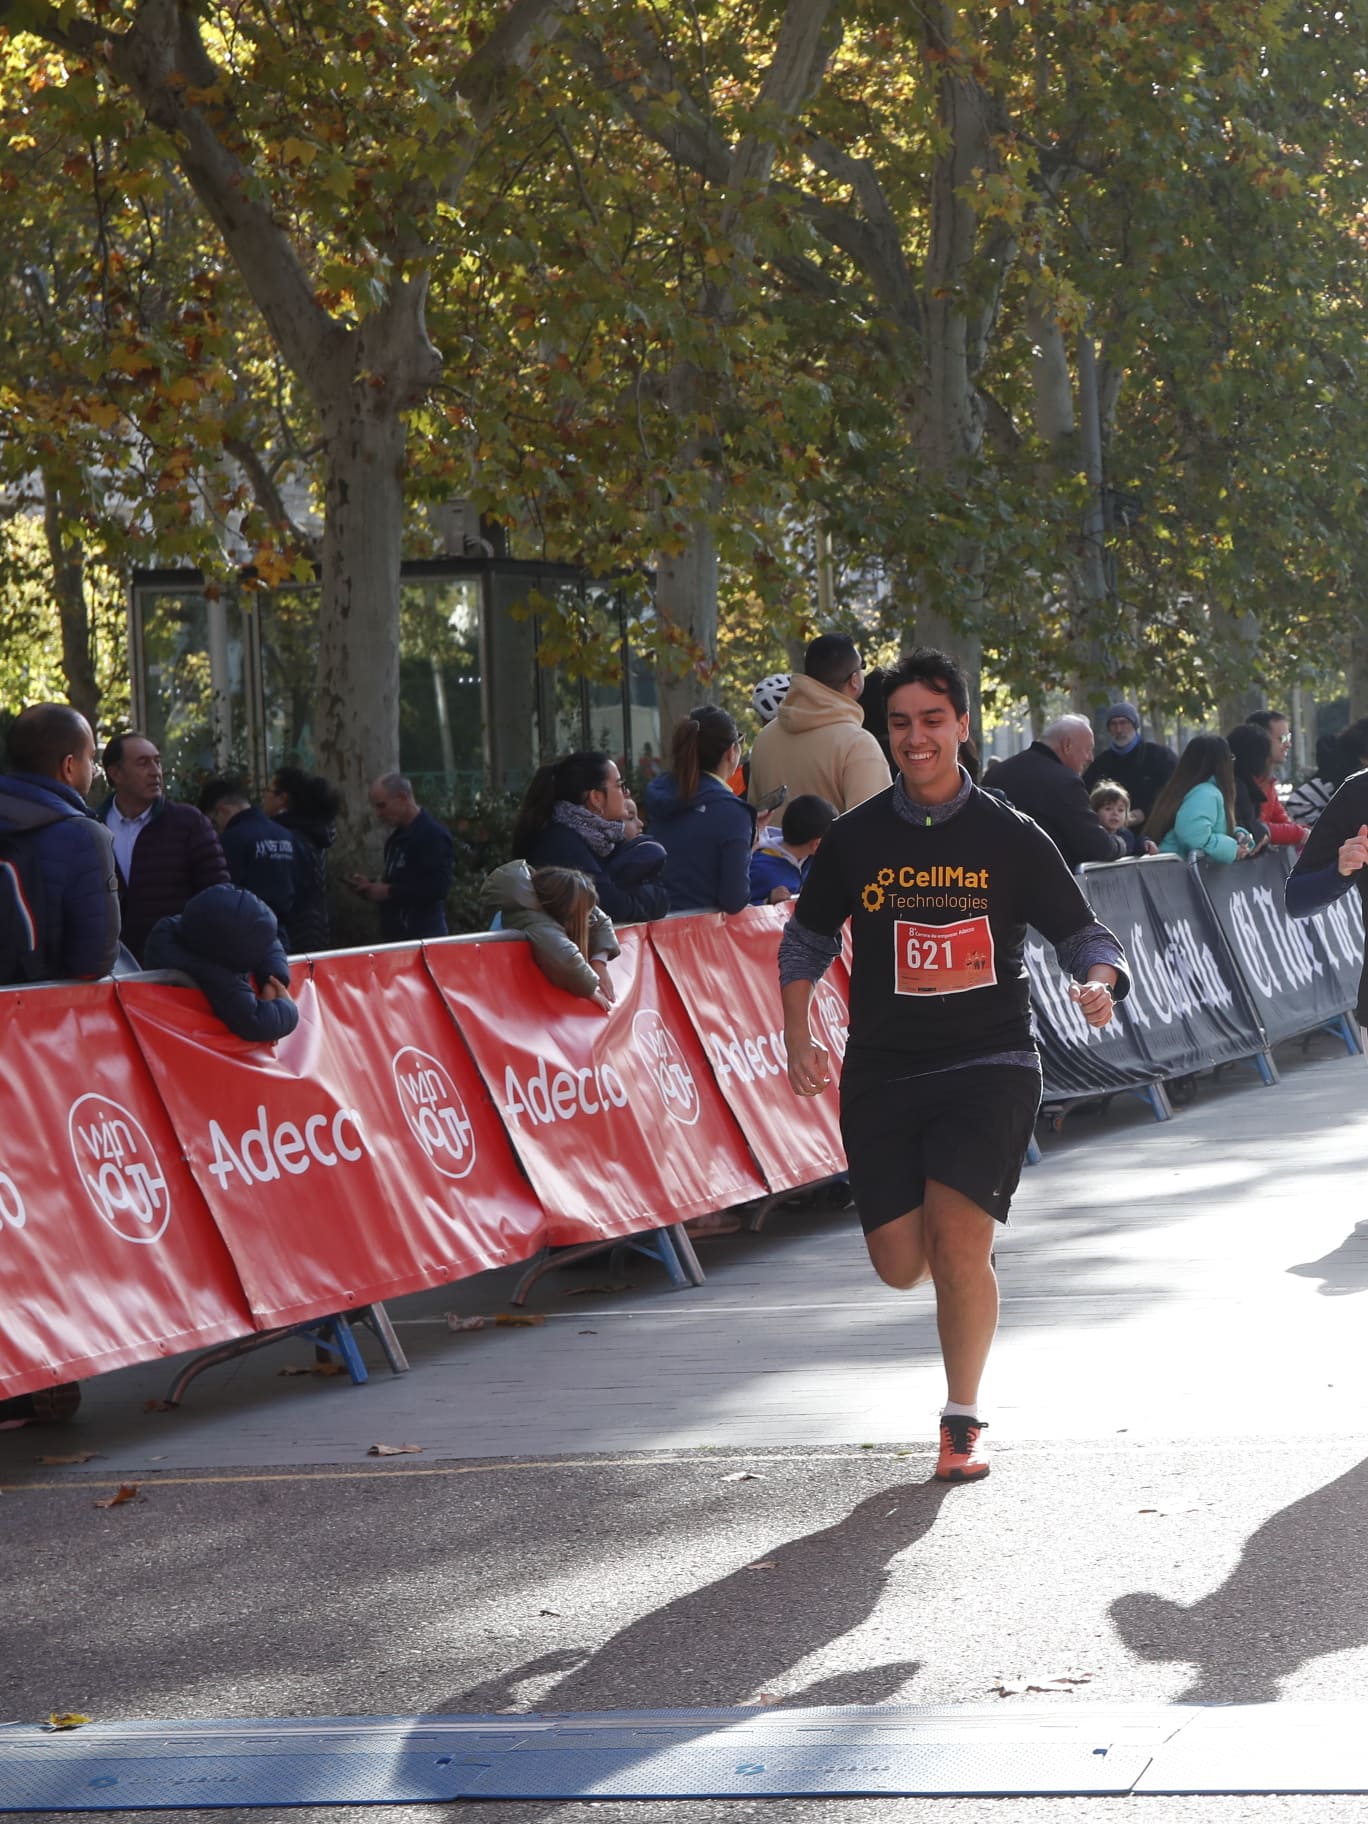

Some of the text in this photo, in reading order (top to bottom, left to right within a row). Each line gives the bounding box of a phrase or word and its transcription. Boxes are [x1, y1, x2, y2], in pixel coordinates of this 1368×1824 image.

[899, 866, 989, 889] CellMat
[888, 893, 988, 911] Technologies
[907, 938, 952, 970] 621
